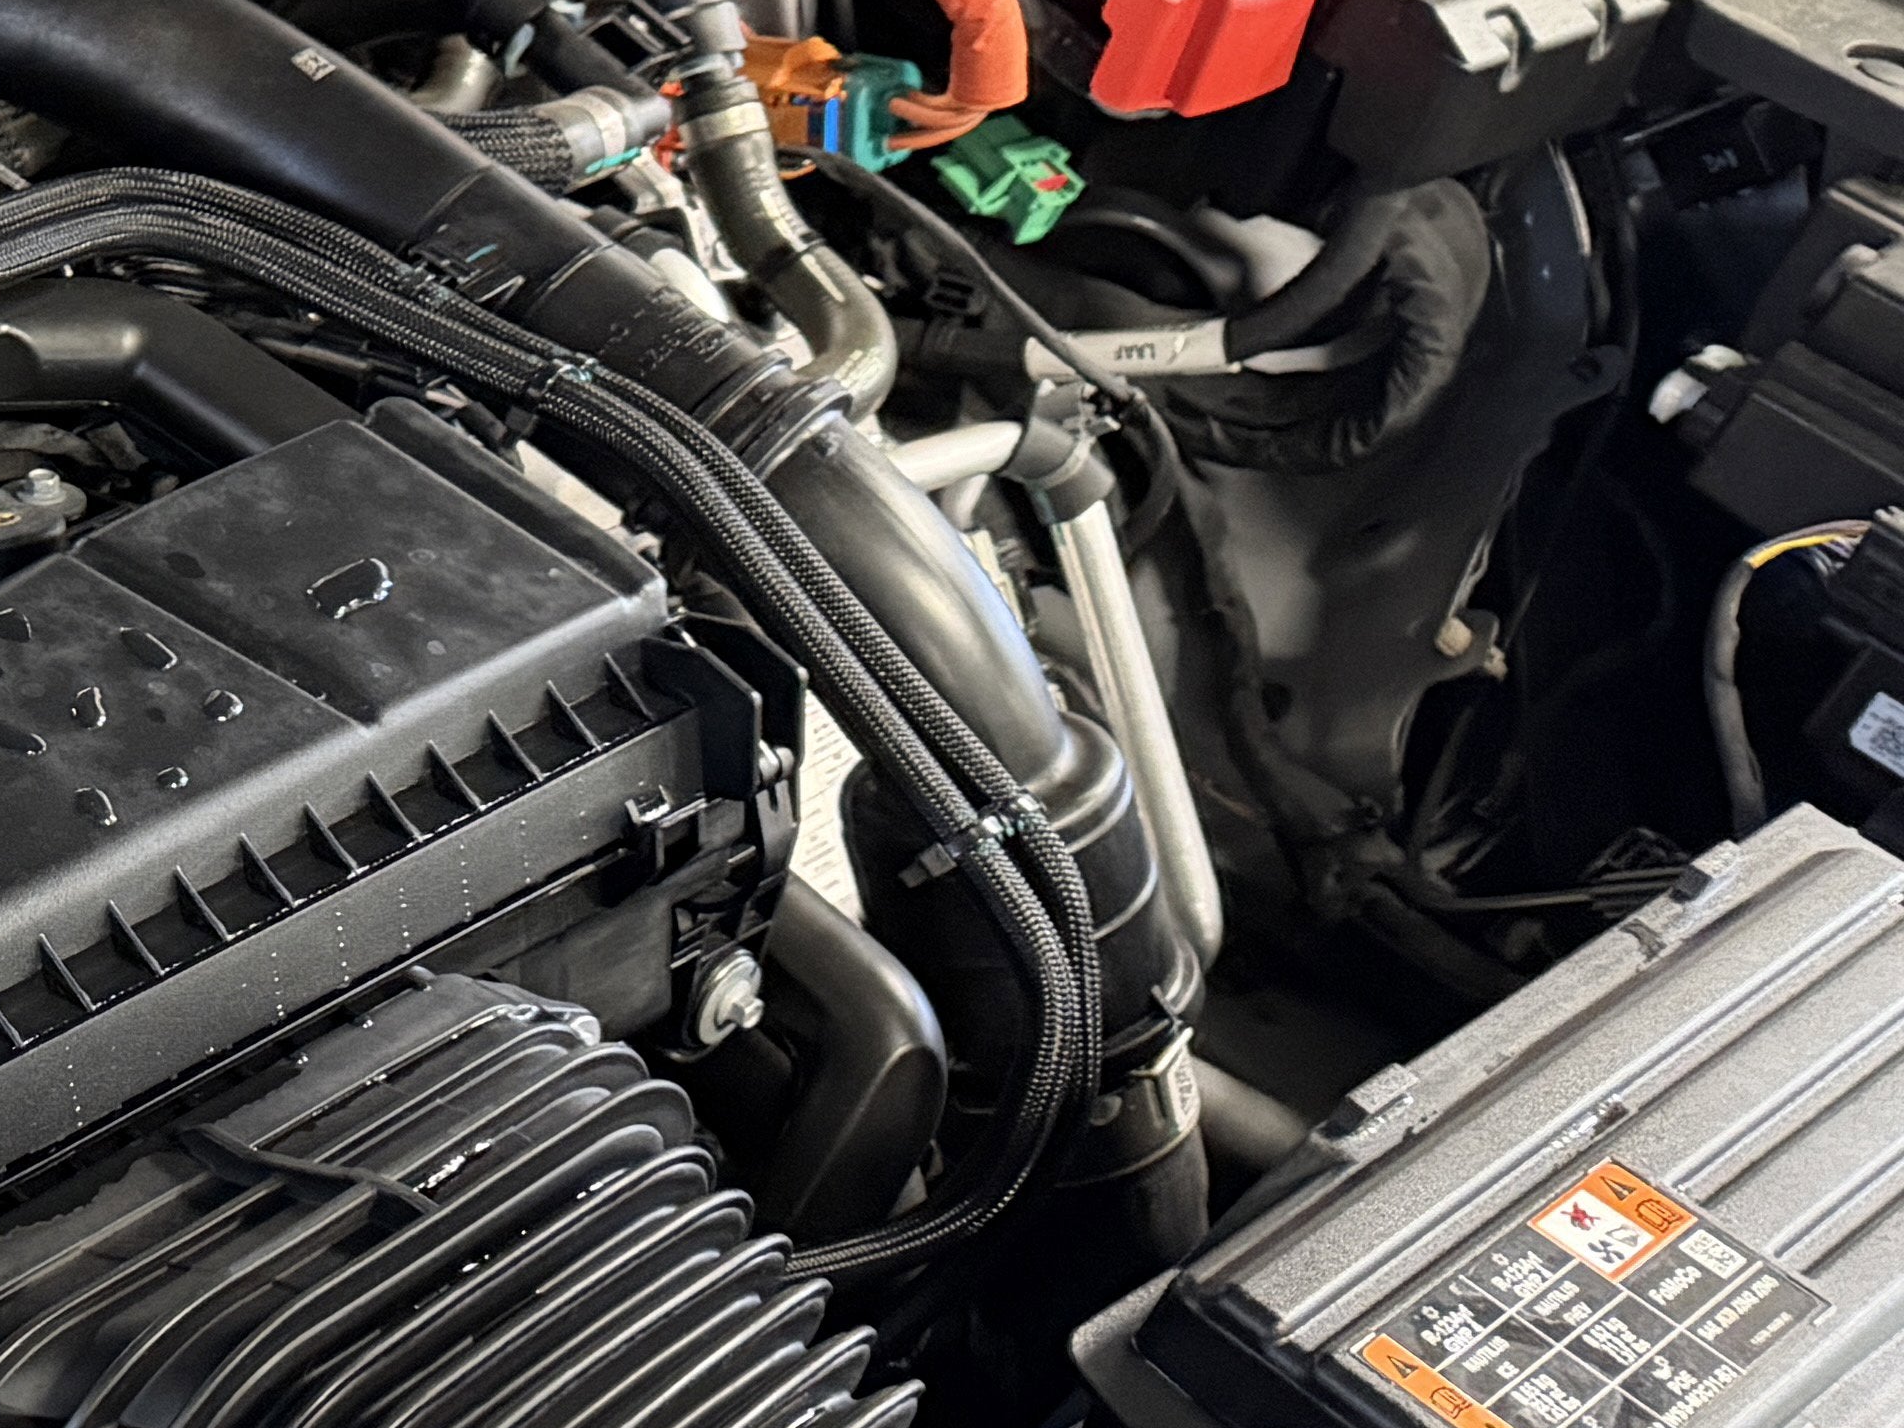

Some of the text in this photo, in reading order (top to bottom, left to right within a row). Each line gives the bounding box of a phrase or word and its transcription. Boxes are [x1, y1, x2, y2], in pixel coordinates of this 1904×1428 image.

[1533, 1281, 1580, 1317] NAUTILUS
[1647, 1264, 1703, 1305] FoMoCo
[1462, 1336, 1510, 1373] NAUTILUS
